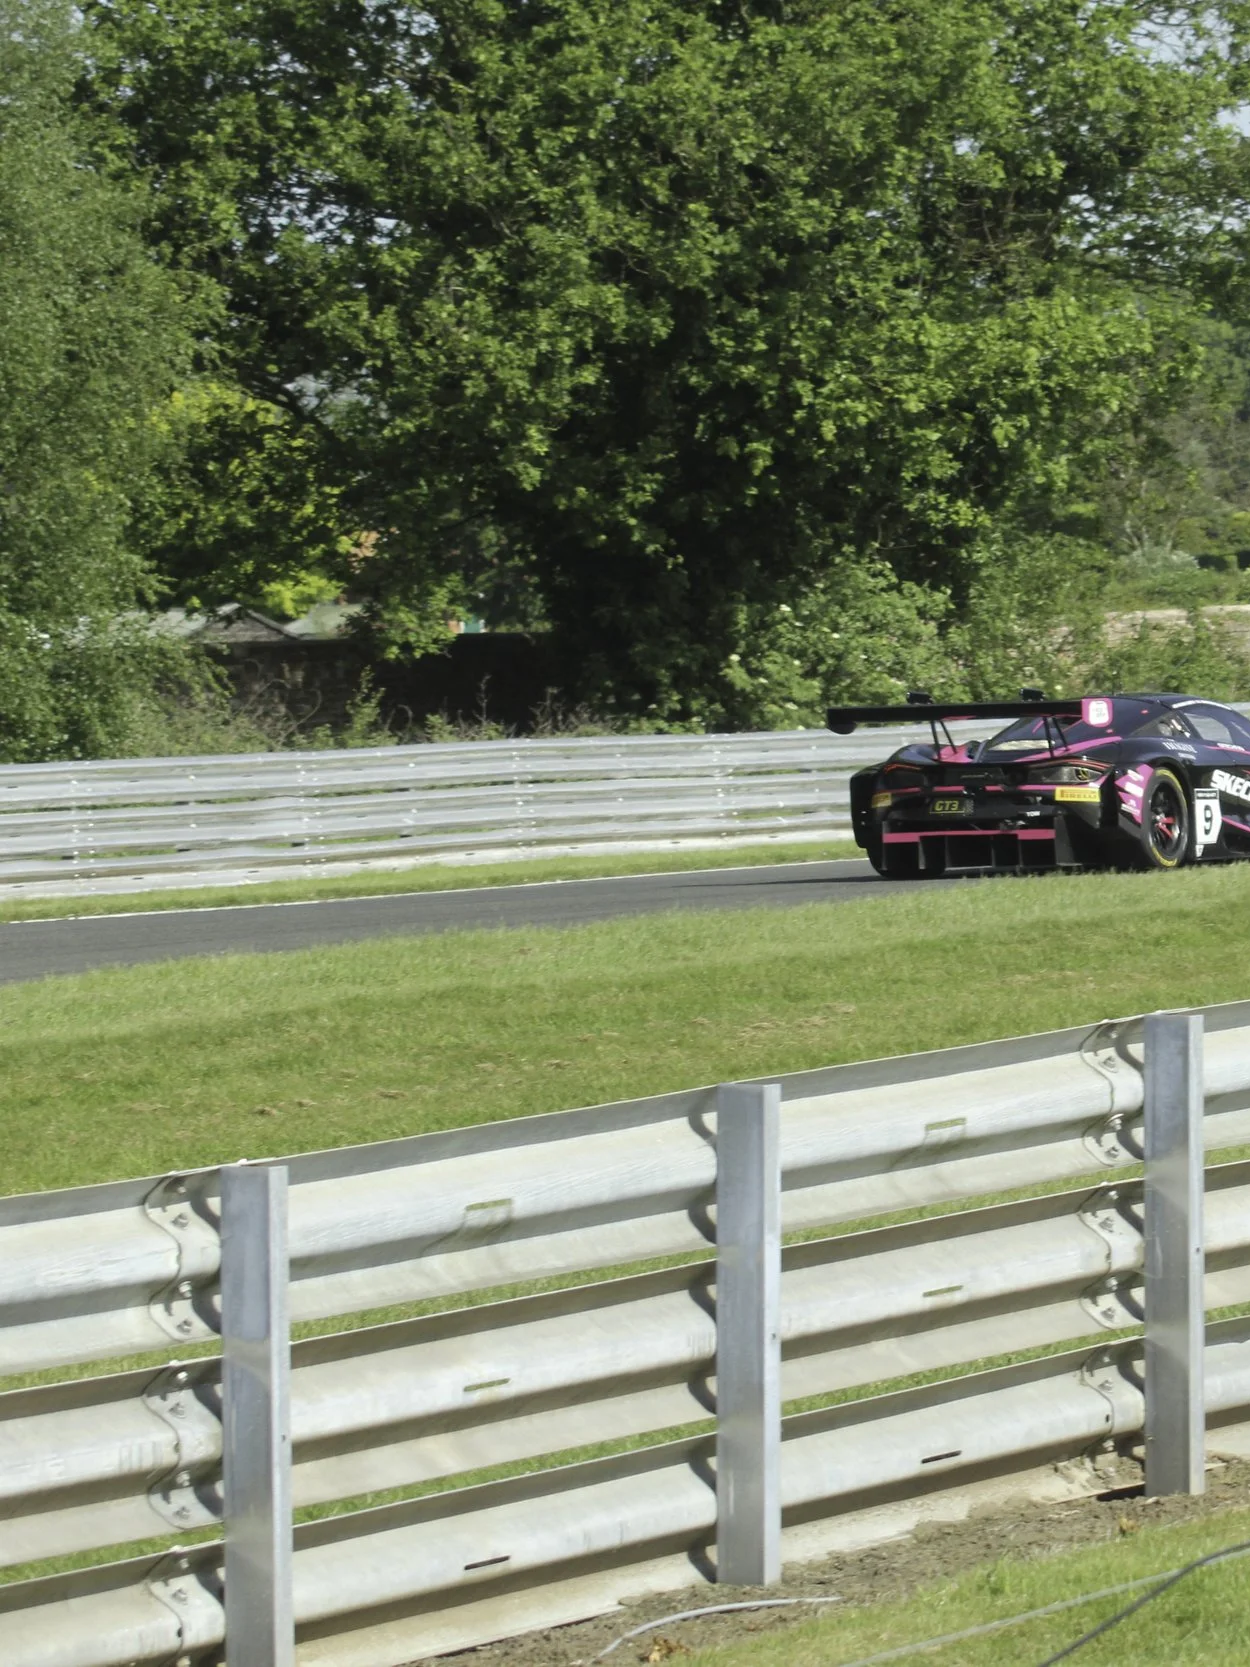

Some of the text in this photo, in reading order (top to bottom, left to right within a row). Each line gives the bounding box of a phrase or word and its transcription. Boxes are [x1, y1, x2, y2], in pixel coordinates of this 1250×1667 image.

[1060, 789, 1097, 799] PIRELLI
[934, 800, 960, 812] GT3
[1203, 804, 1213, 836] 9
